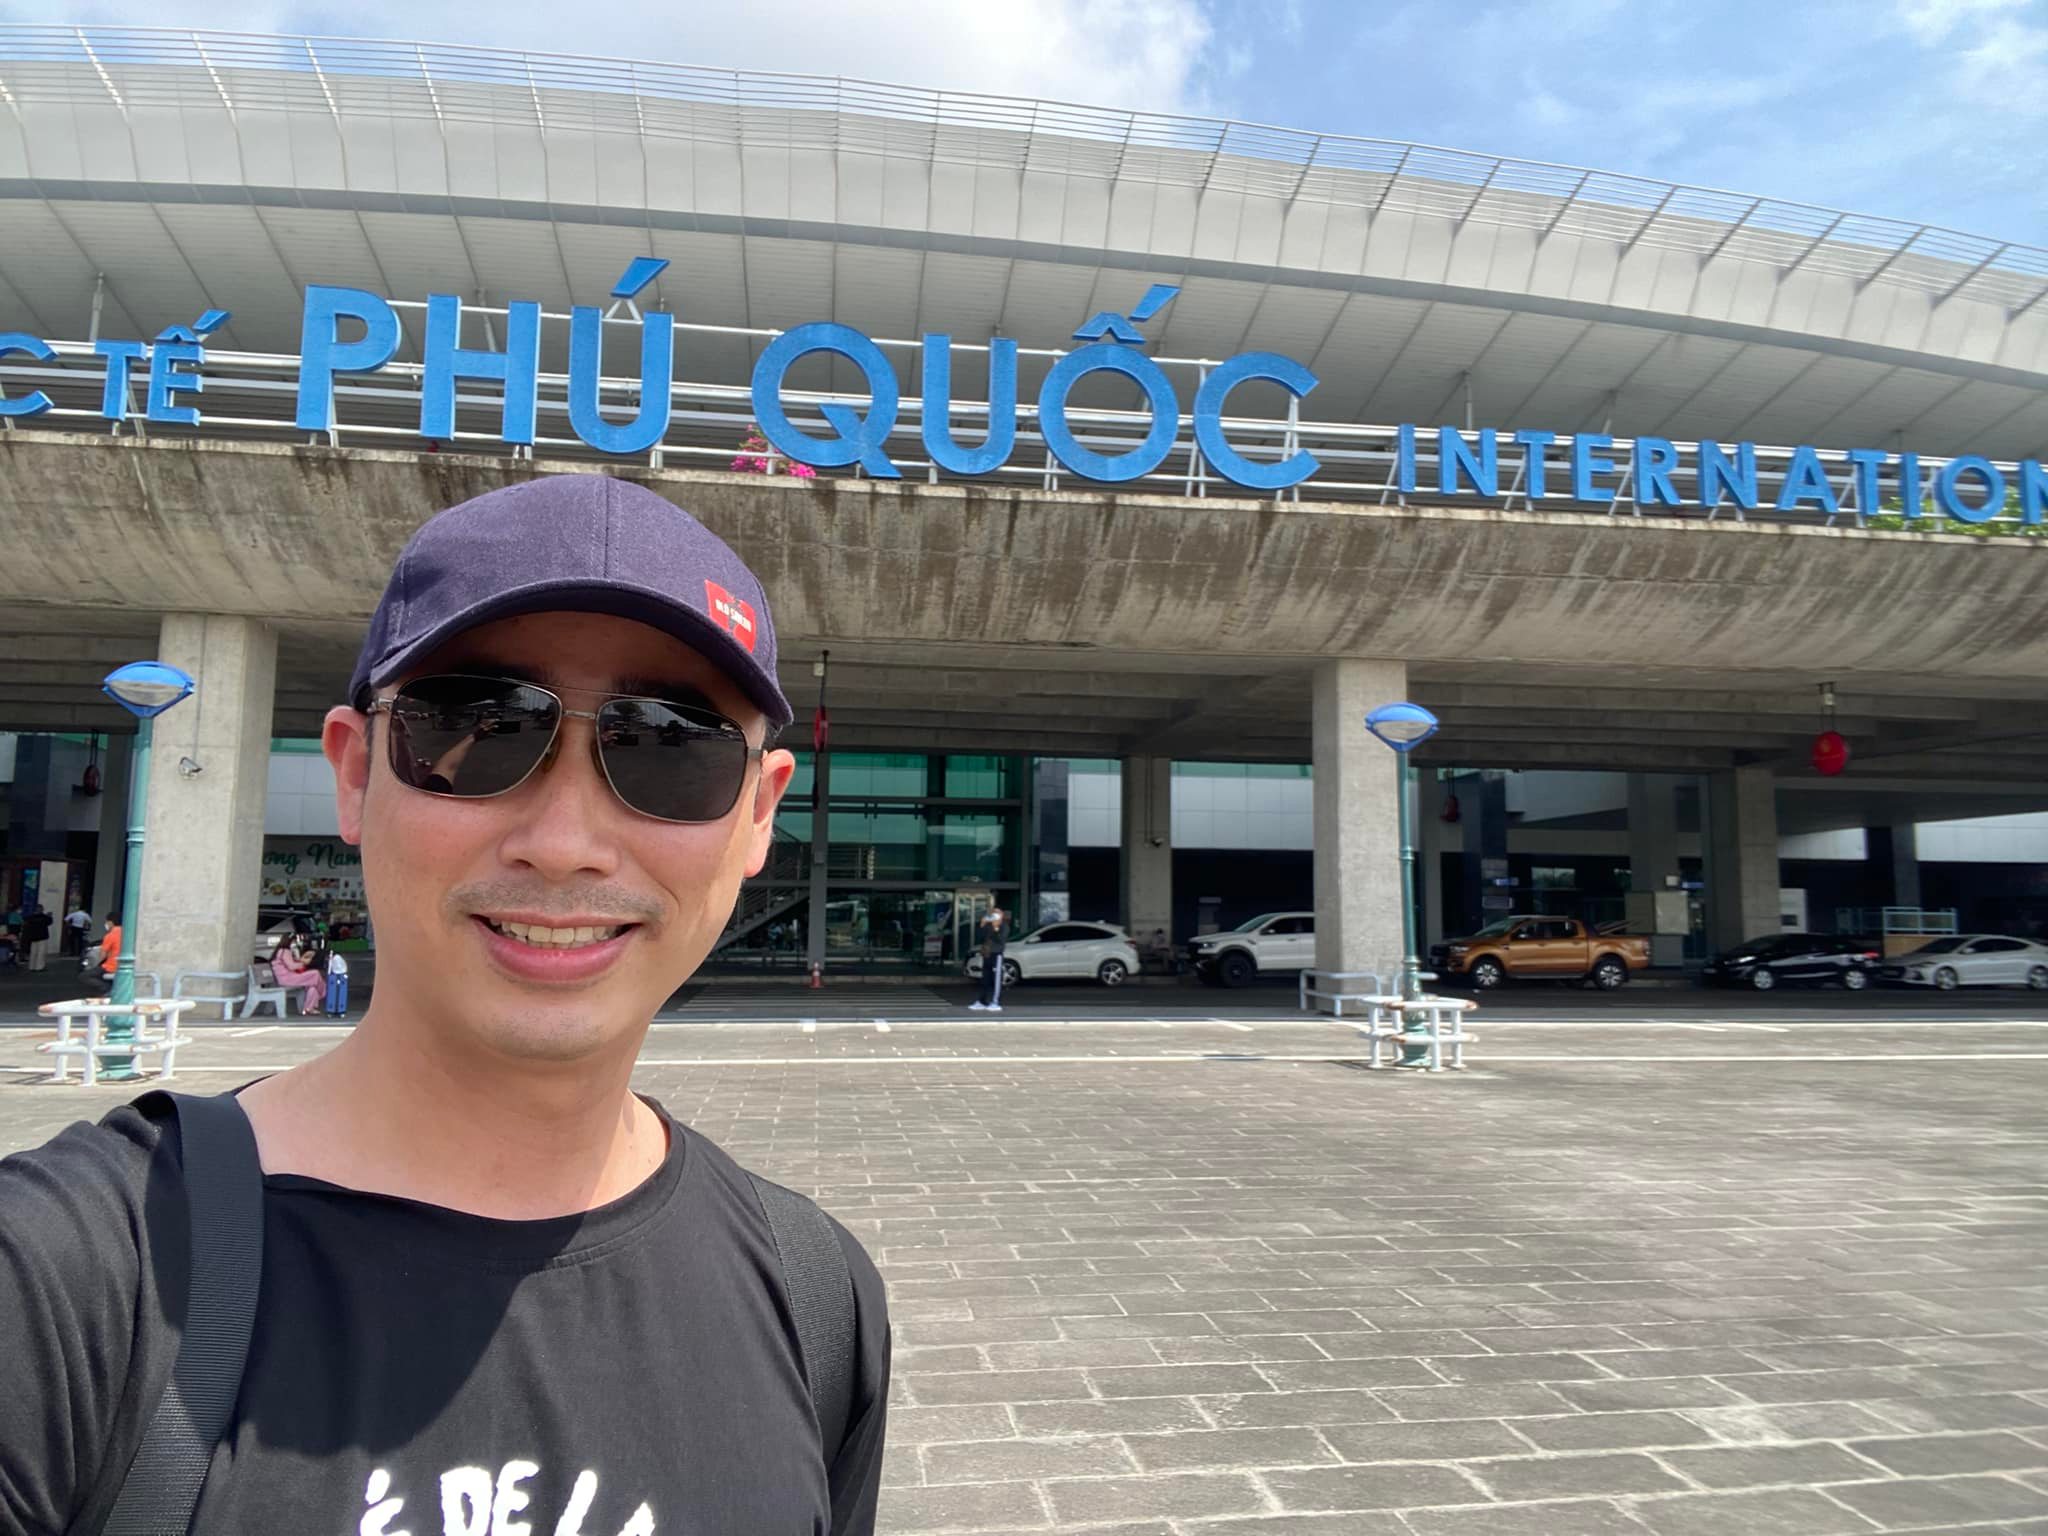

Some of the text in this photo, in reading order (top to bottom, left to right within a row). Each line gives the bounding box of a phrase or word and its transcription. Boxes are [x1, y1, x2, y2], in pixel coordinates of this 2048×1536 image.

[95, 309, 231, 427] TẾ
[296, 256, 671, 454] PHÚ
[751, 283, 1322, 490] QUỐC
[440, 1460, 540, 1536] DE
